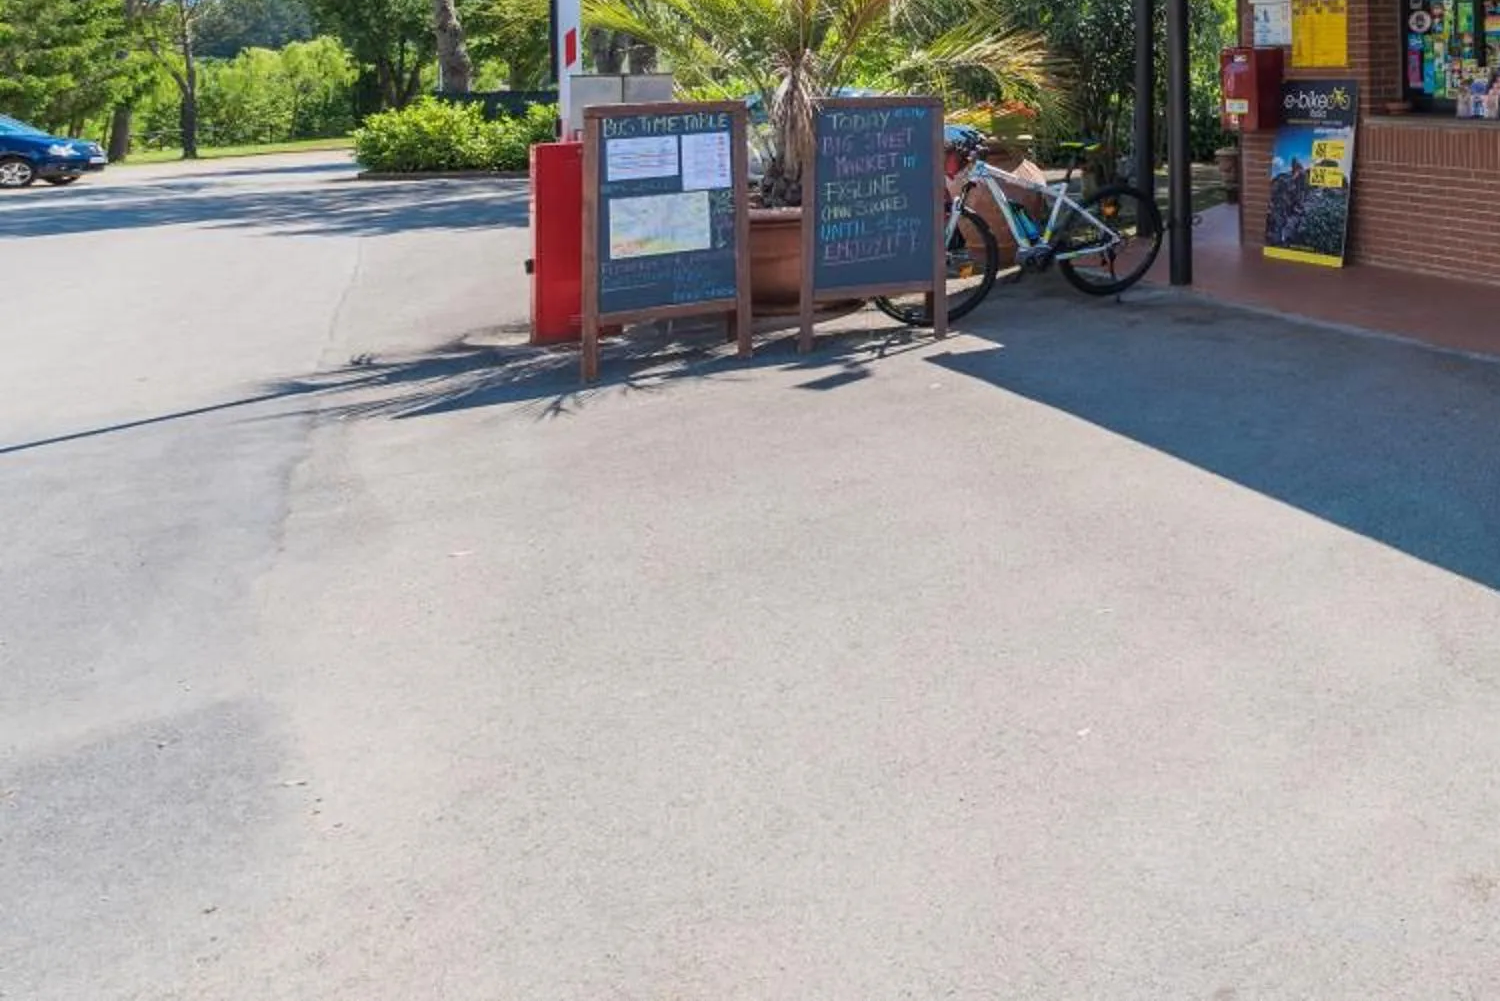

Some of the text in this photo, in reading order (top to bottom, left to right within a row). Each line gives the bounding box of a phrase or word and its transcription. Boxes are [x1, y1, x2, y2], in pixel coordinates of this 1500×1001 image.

[1284, 90, 1328, 110] e-bike
[826, 111, 891, 132] TODAY
[822, 136, 854, 157] BIG
[834, 154, 900, 178] MARKET
[821, 222, 871, 241] UNTIL
